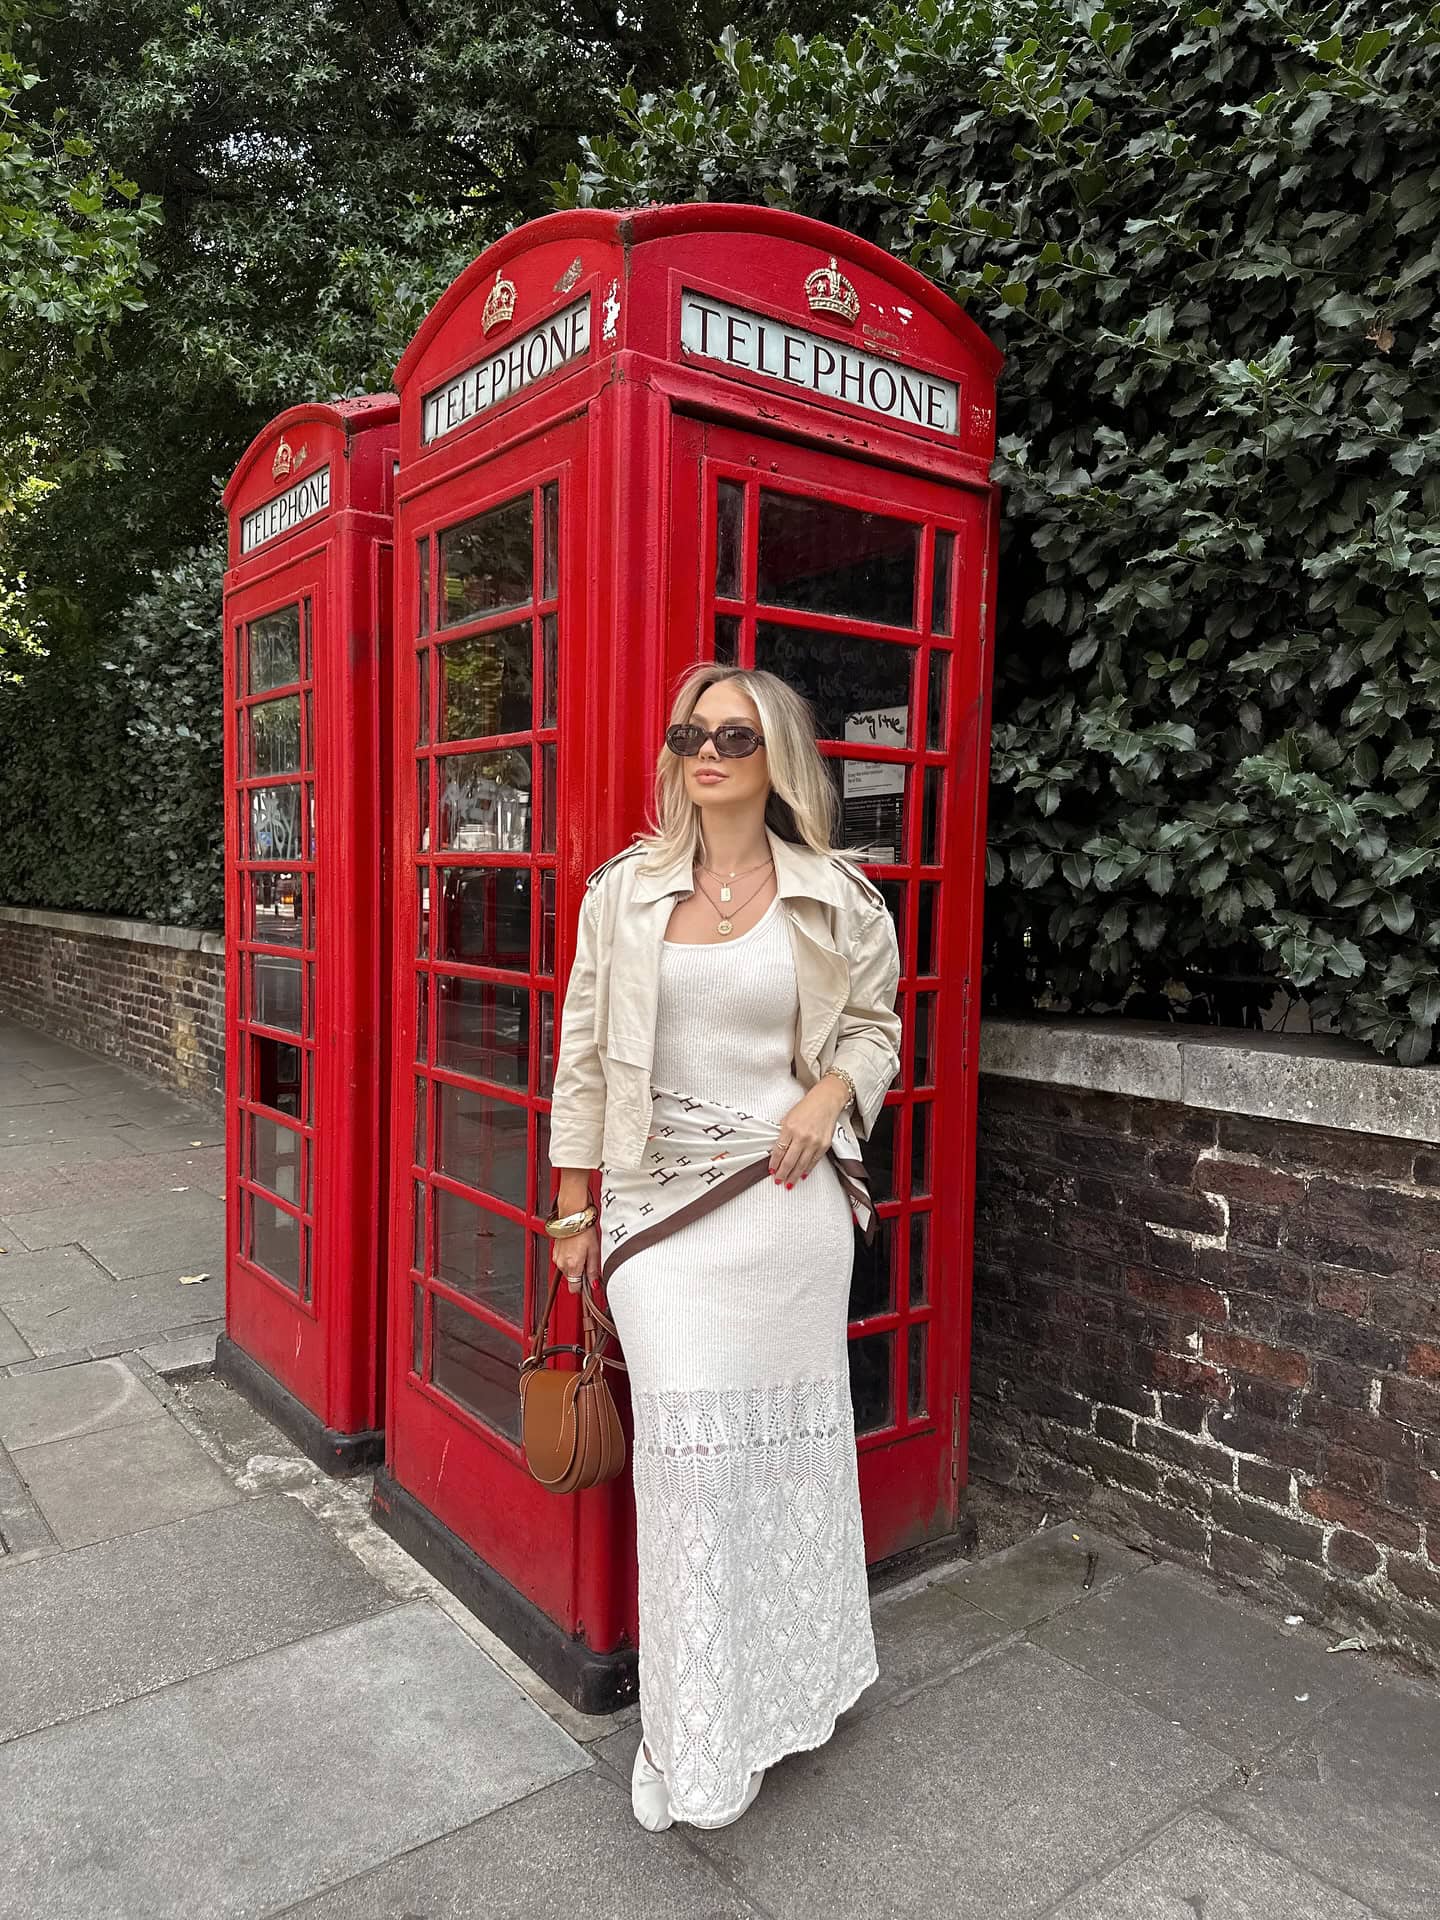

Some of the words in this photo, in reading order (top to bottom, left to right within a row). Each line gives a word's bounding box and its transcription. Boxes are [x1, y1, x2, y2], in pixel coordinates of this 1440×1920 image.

[431, 306, 588, 436] TELEPHONE
[687, 302, 947, 429] TELEPHONE
[246, 471, 329, 549] TELEPHONE
[702, 1124, 736, 1141] H
[649, 1167, 679, 1186] H
[698, 1166, 725, 1185] H
[639, 1202, 654, 1216] H
[609, 1223, 628, 1243] H
